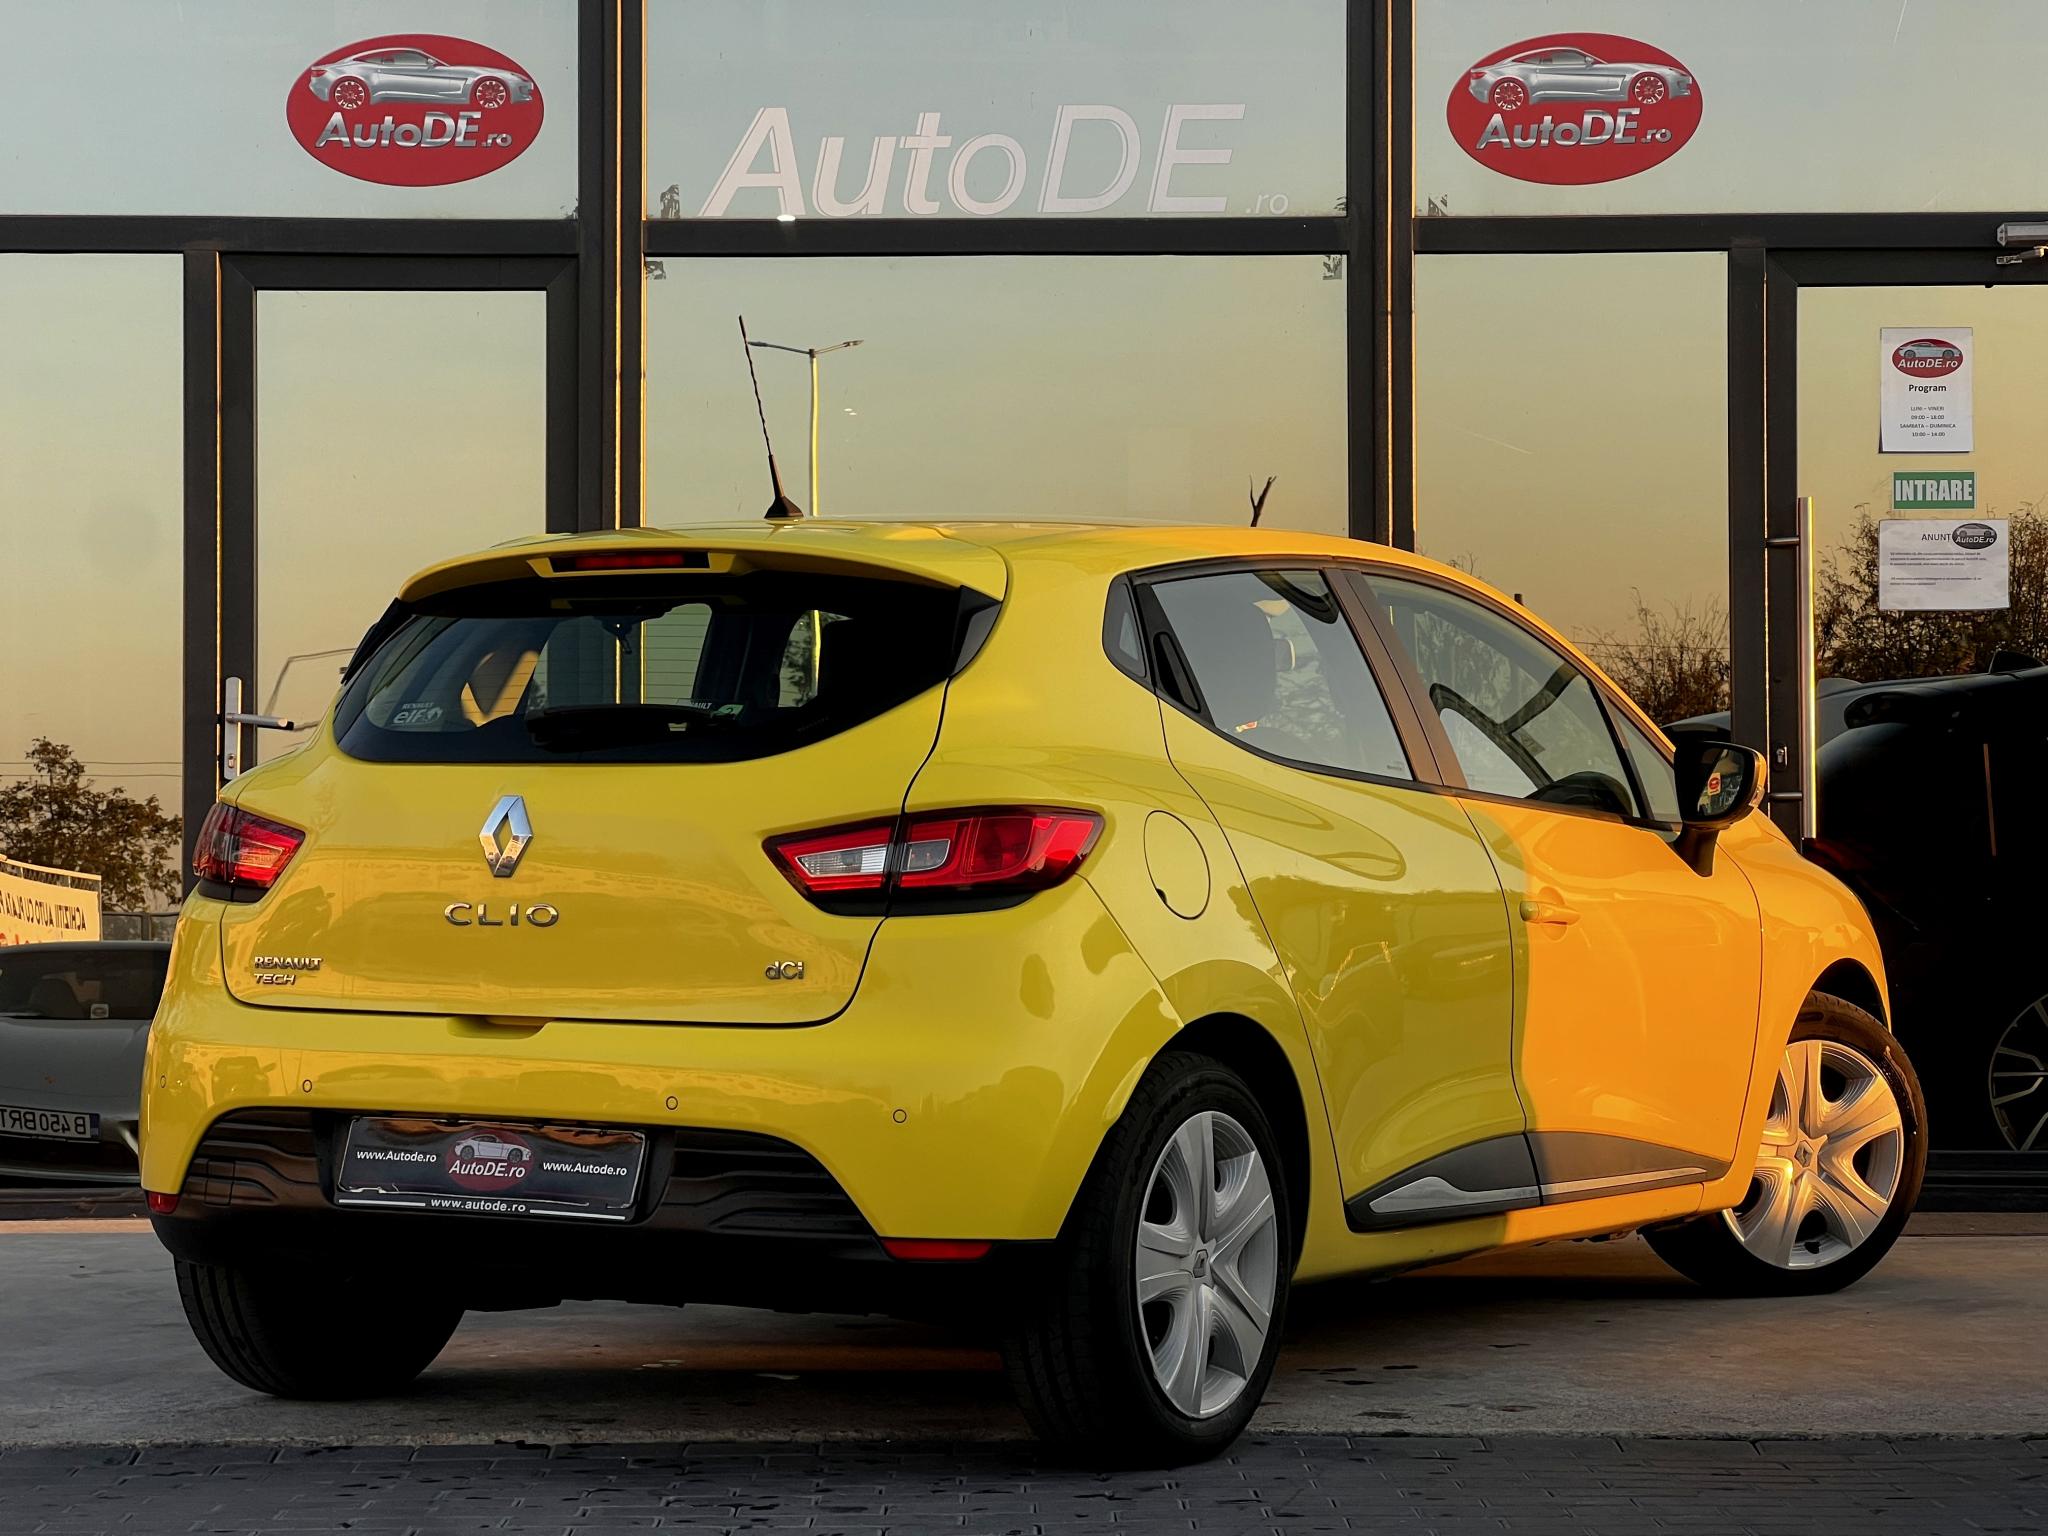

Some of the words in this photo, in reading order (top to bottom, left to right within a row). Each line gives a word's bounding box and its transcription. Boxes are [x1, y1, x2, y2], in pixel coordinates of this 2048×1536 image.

[1897, 358, 1959, 369] AutoDE.ro
[1908, 384, 1947, 394] Program
[1895, 480, 1973, 501] INTRARE
[1955, 536, 1995, 544] AutoDE.ro
[444, 902, 559, 927] CLIO
[254, 956, 324, 971] RENAULT
[253, 973, 297, 986] TECH
[356, 1149, 437, 1163] www.Autode.ro
[449, 1160, 526, 1178] AutoDE.ro
[543, 1161, 628, 1176] www.Autode.ro
[431, 1198, 526, 1212] www.autode.ro
